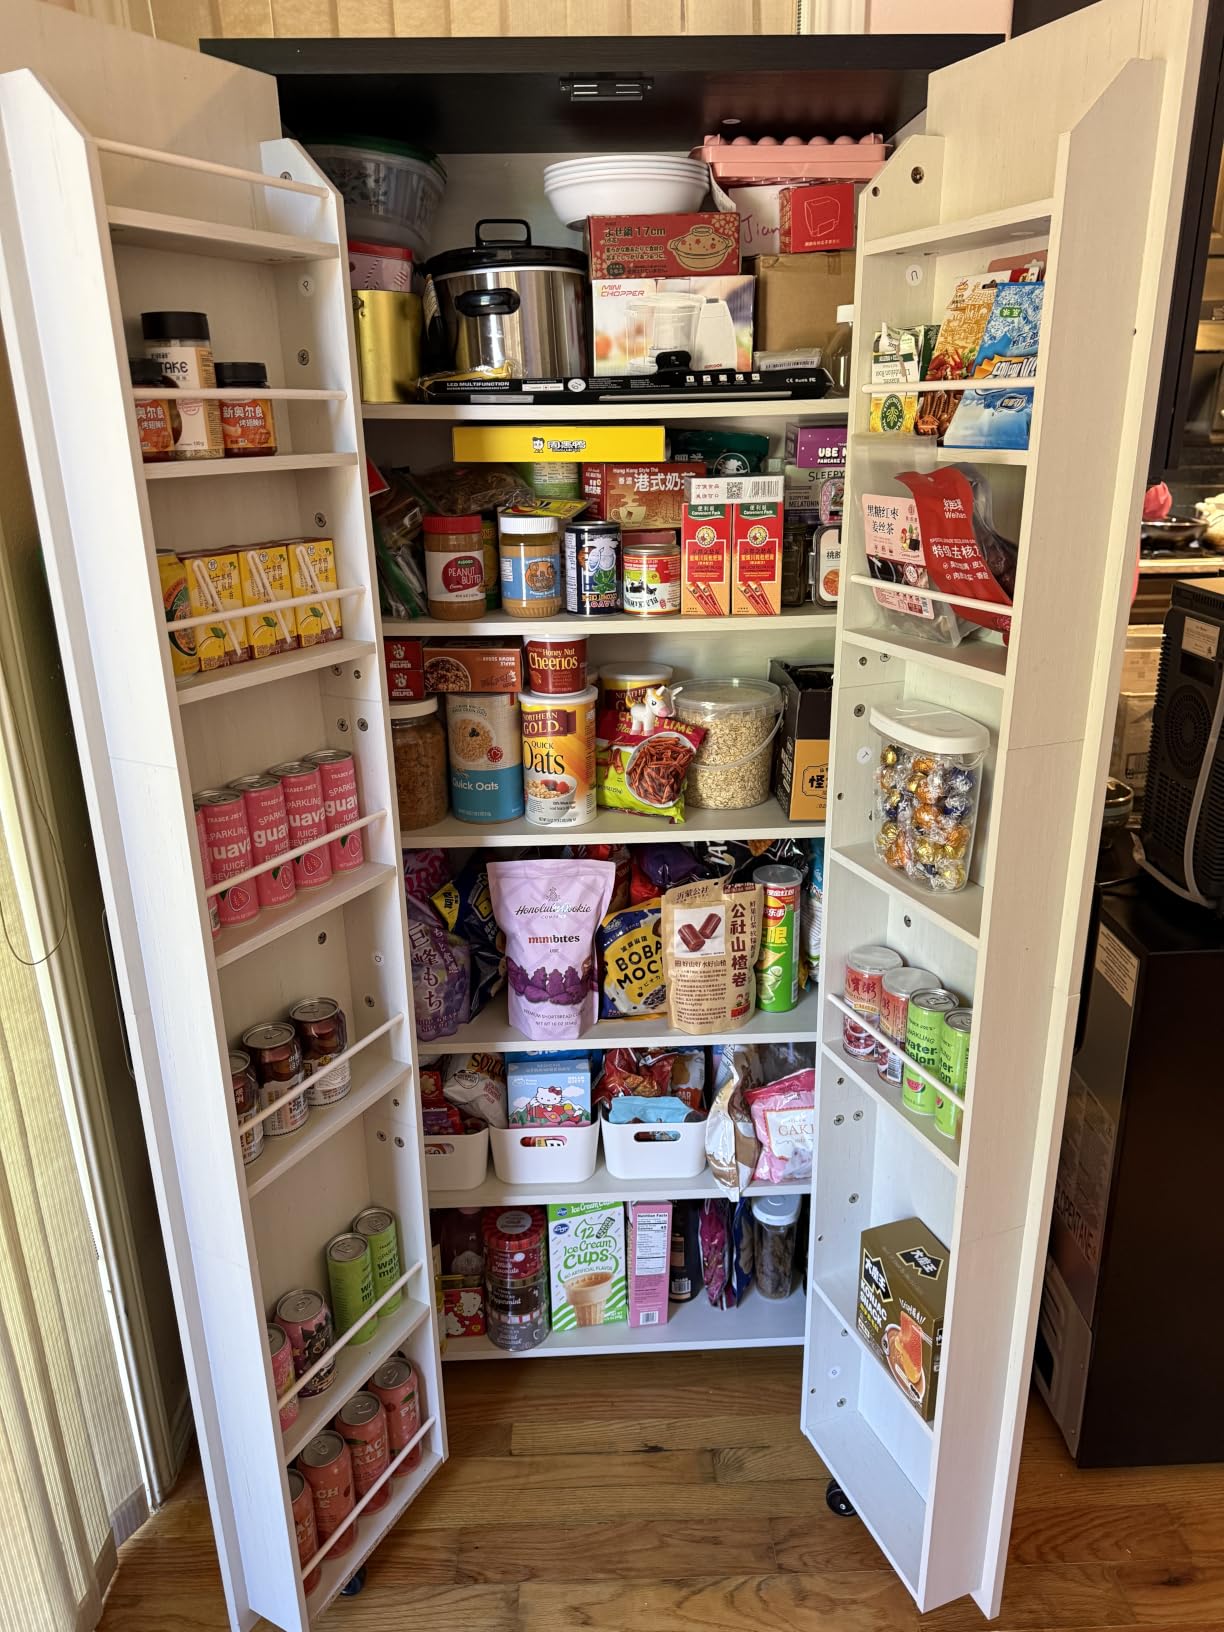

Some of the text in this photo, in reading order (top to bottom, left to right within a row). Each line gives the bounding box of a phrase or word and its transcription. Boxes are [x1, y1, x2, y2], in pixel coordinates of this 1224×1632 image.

[635, 226, 666, 236] 17cm
[818, 447, 839, 457] UBE
[448, 567, 475, 577] PEANUT
[542, 648, 576, 658] Honey Nut
[529, 651, 578, 670] Cheerios
[523, 711, 558, 721] NORTHERN
[523, 720, 559, 734] GOLD
[664, 719, 695, 734] LIME
[531, 740, 554, 750] QUICK
[475, 781, 499, 791] Oats
[287, 797, 321, 810] PARKLING
[289, 808, 325, 827] uava
[297, 827, 318, 838] JUICE
[221, 860, 245, 872] JUICE
[730, 903, 748, 987] 公社山楂卷
[615, 940, 662, 972] BOBA
[580, 1227, 595, 1240] 12
[563, 1240, 612, 1257] Ice Cream
[563, 1248, 610, 1270] Cups
[860, 1282, 888, 1322] KONJAC
[859, 1292, 883, 1329] SNACK
